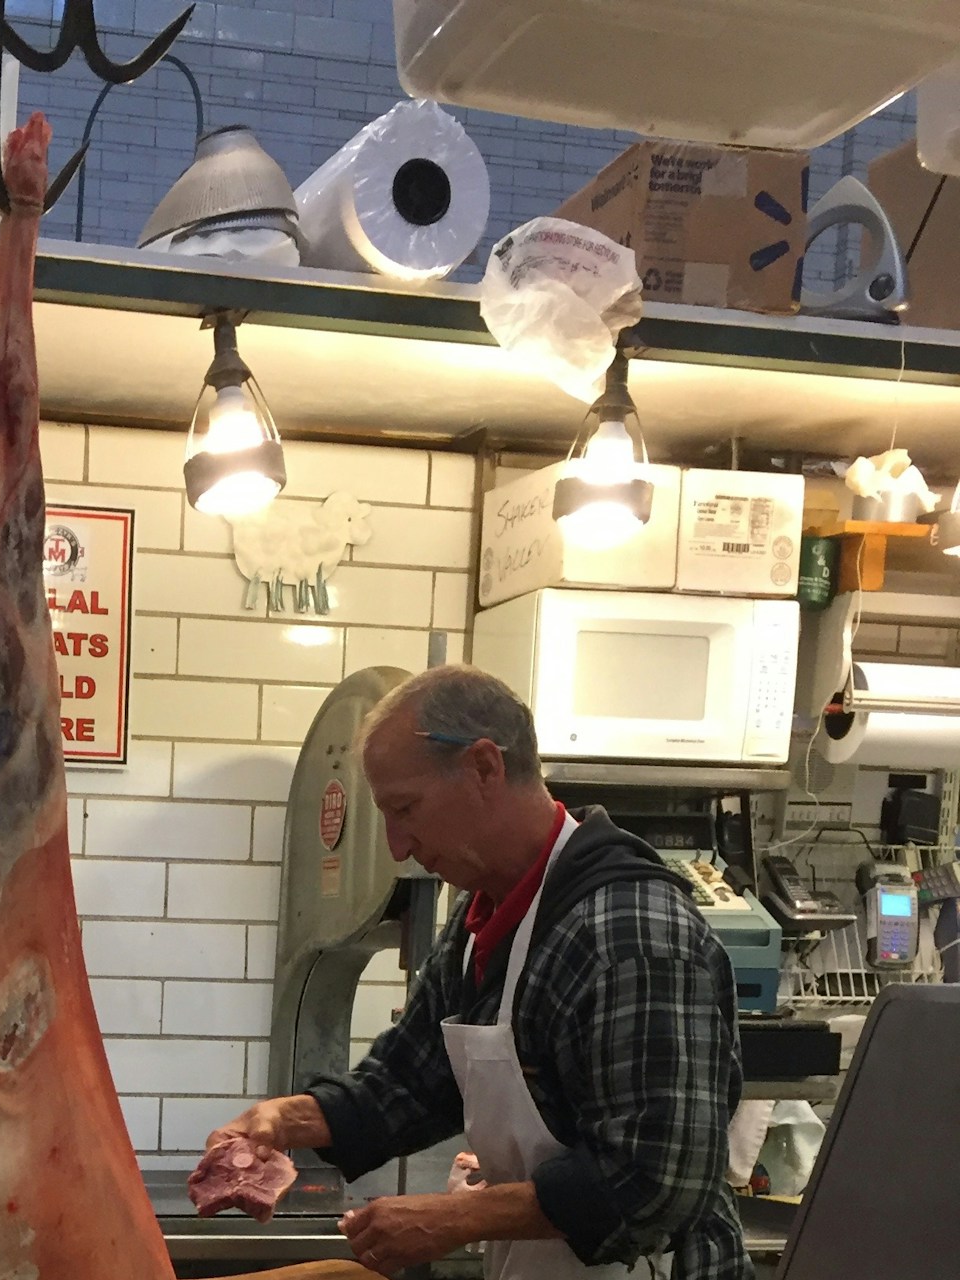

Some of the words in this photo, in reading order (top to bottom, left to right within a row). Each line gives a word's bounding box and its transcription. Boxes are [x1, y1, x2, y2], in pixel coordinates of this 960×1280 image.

[48, 547, 66, 563] M
[48, 588, 109, 615] LAL
[53, 631, 109, 658] ATS
[59, 675, 96, 700] LD
[60, 717, 95, 742] RE
